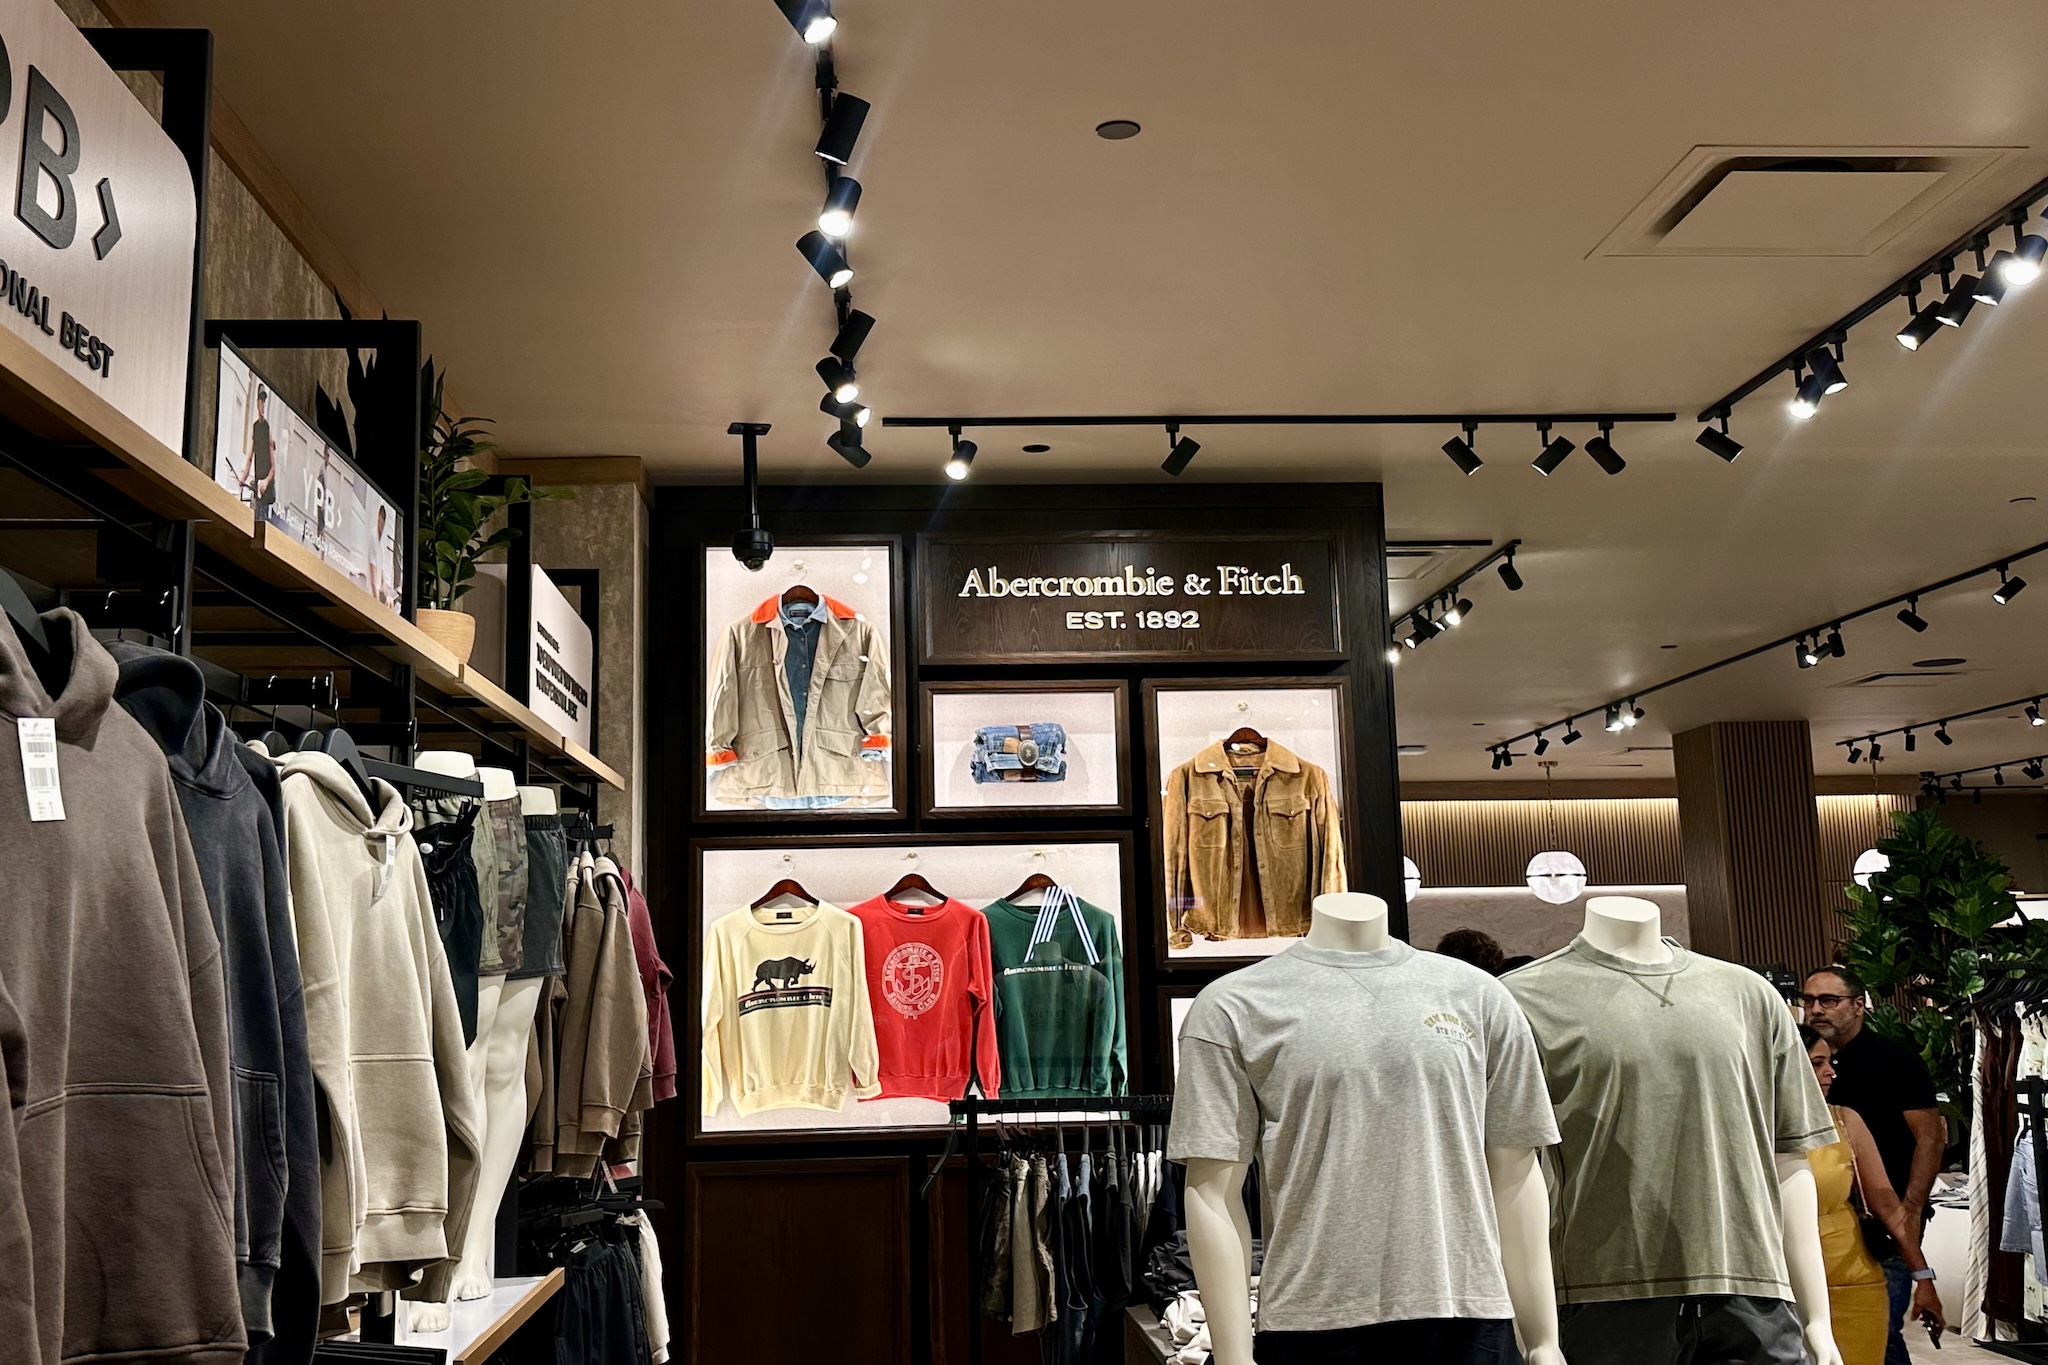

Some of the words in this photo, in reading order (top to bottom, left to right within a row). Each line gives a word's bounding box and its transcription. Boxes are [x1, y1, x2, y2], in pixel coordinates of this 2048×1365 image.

[0, 32, 80, 250] B
[60, 311, 114, 378] BEST
[302, 467, 335, 529] YPB
[958, 565, 1175, 598] Abercrombie
[1183, 572, 1211, 596] &
[1216, 563, 1305, 596] Fitch
[1065, 611, 1127, 630] EST.
[1136, 610, 1201, 630] 1892
